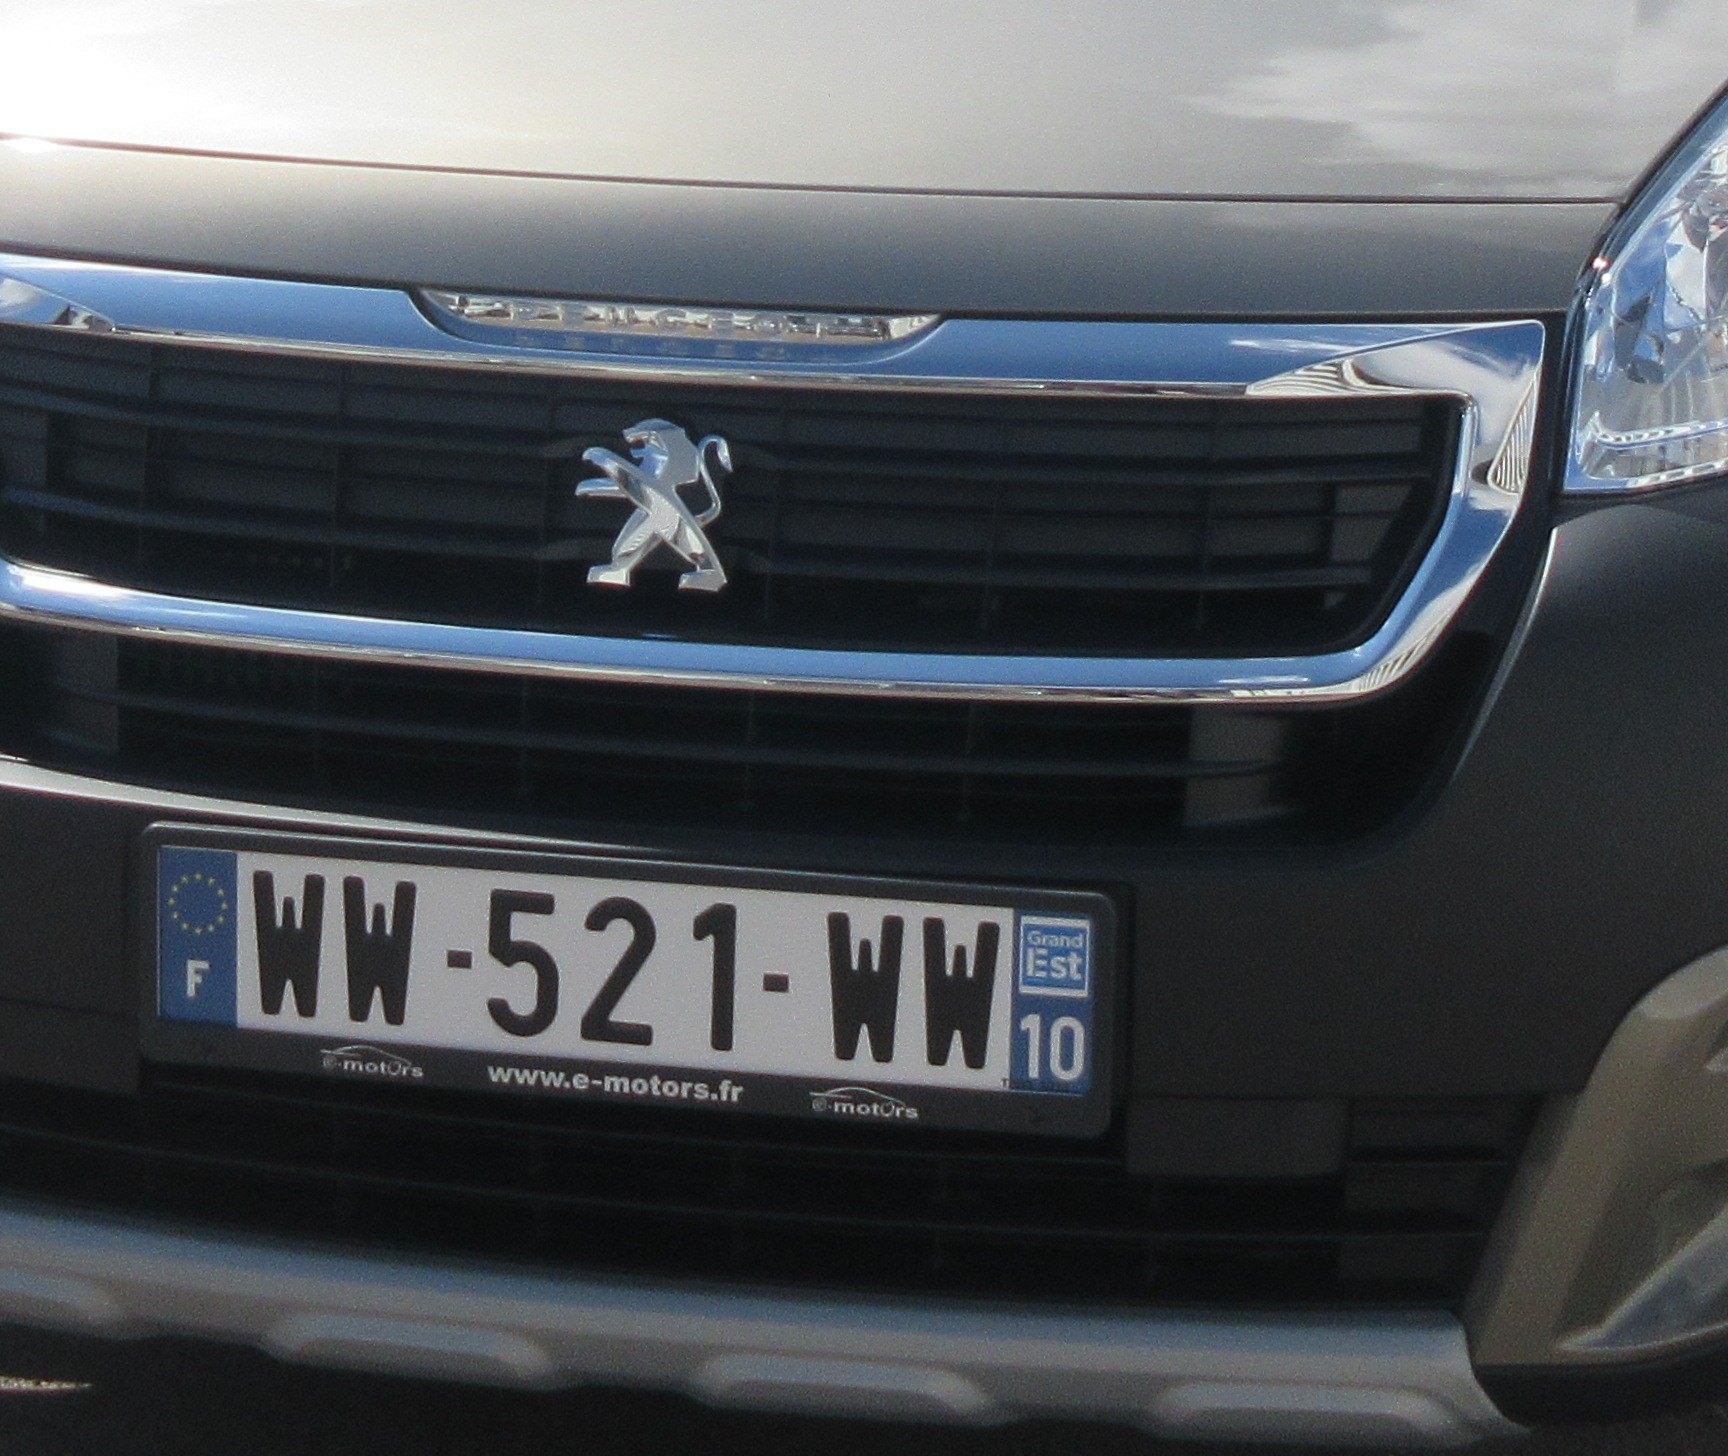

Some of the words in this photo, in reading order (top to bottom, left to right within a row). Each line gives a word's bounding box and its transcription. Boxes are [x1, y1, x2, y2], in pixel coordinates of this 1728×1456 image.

[1026, 930, 1084, 948] Grand
[186, 959, 210, 997] F
[1026, 948, 1083, 981] Est
[1020, 1013, 1086, 1081] 10
[487, 1065, 744, 1103] www.e-motors.fr
